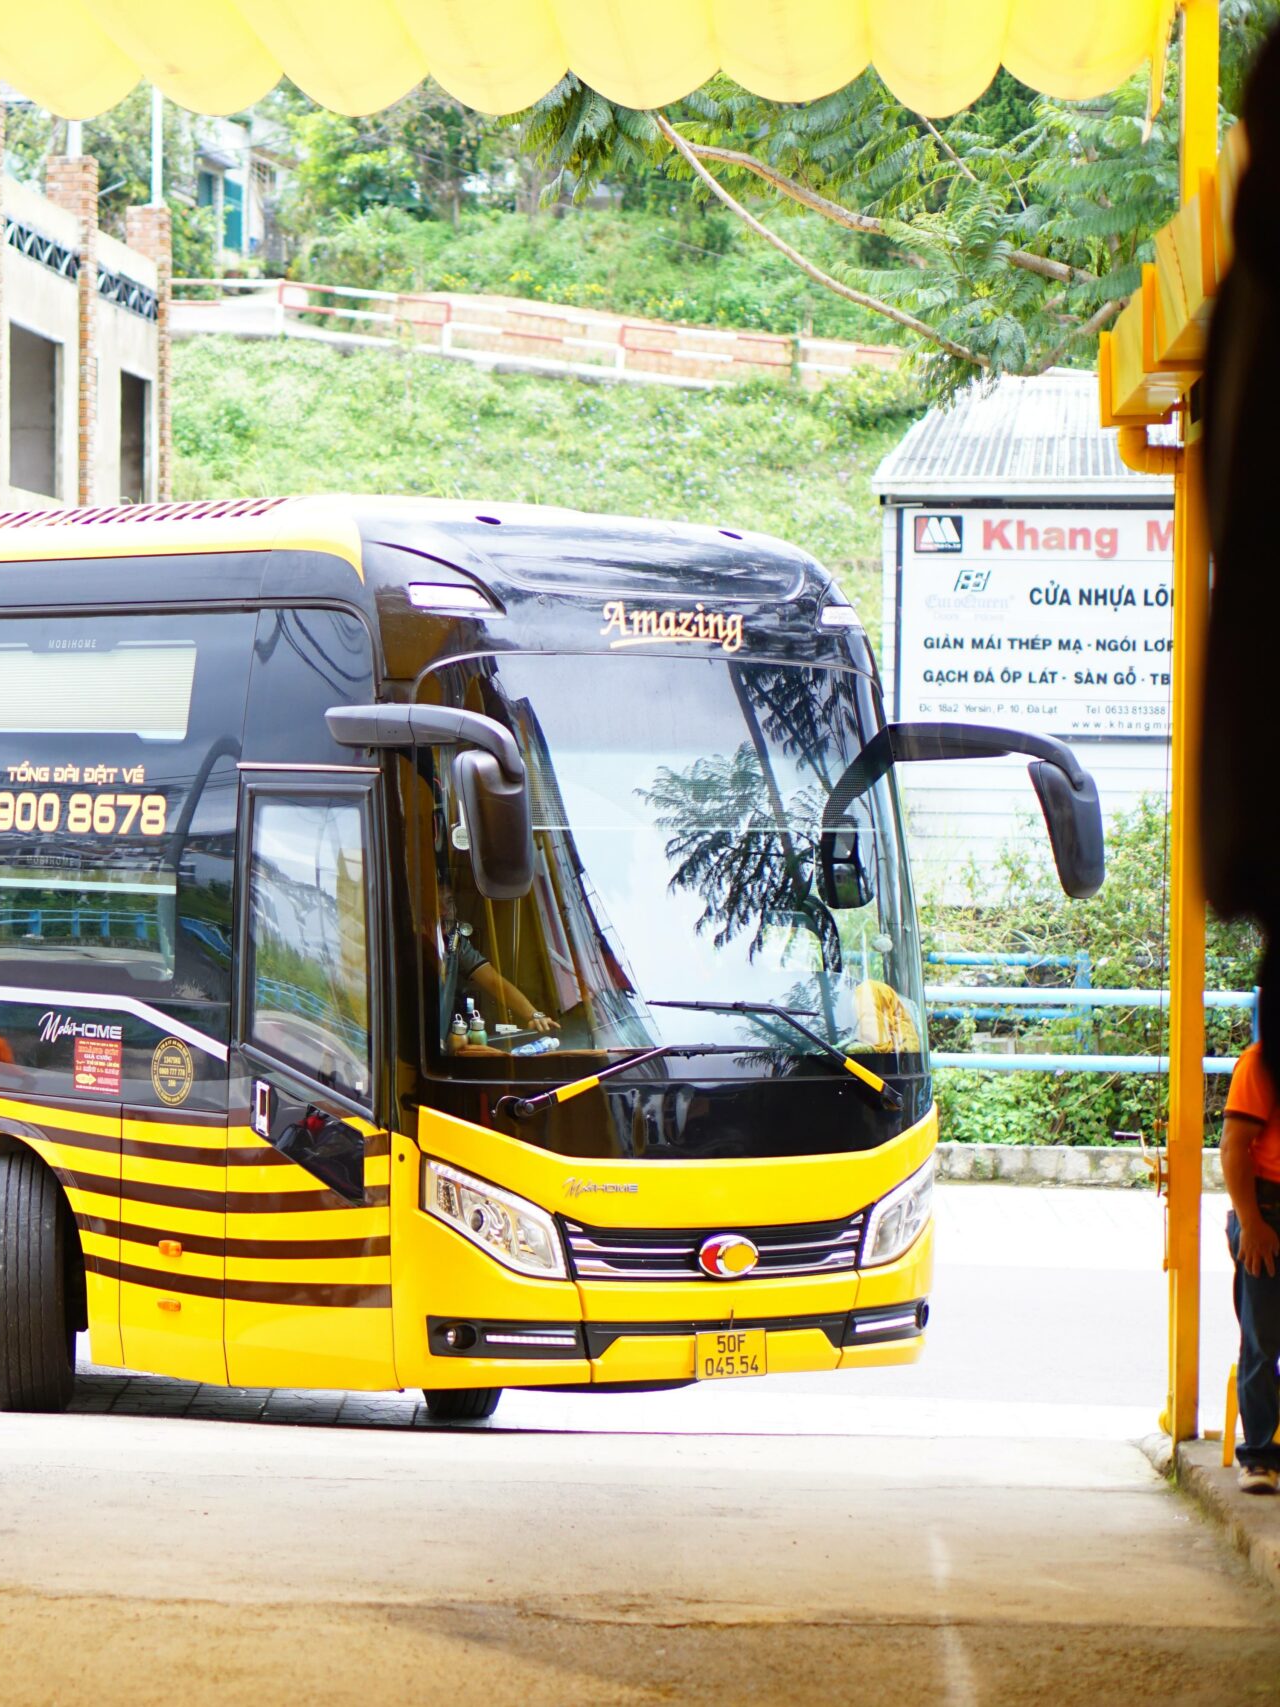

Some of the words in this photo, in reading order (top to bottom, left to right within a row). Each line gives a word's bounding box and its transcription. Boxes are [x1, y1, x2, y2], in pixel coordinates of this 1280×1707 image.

[981, 518, 1119, 559] Khang
[1029, 580, 1072, 607] CỬA
[1078, 584, 1137, 612] NHỰA
[600, 600, 743, 653] Amazing
[48, 639, 98, 649] MOBIHOME
[971, 633, 1002, 650] MÁI
[1007, 634, 1053, 651] THÉP
[1058, 638, 1083, 655] MẠ
[1095, 635, 1137, 652] NGÓI
[923, 669, 969, 687] GẠCH
[973, 667, 996, 683] ĐÁ
[1028, 667, 1059, 685] LÁT
[1113, 665, 1137, 686] GỖ
[7, 760, 50, 783] TỔNG
[53, 764, 80, 782] ĐÀI
[83, 764, 118, 786] ĐẶT
[122, 764, 145, 784] VÉ
[67, 792, 167, 837] 8678
[717, 1333, 746, 1353] 50F
[705, 1354, 759, 1376] 045.54
